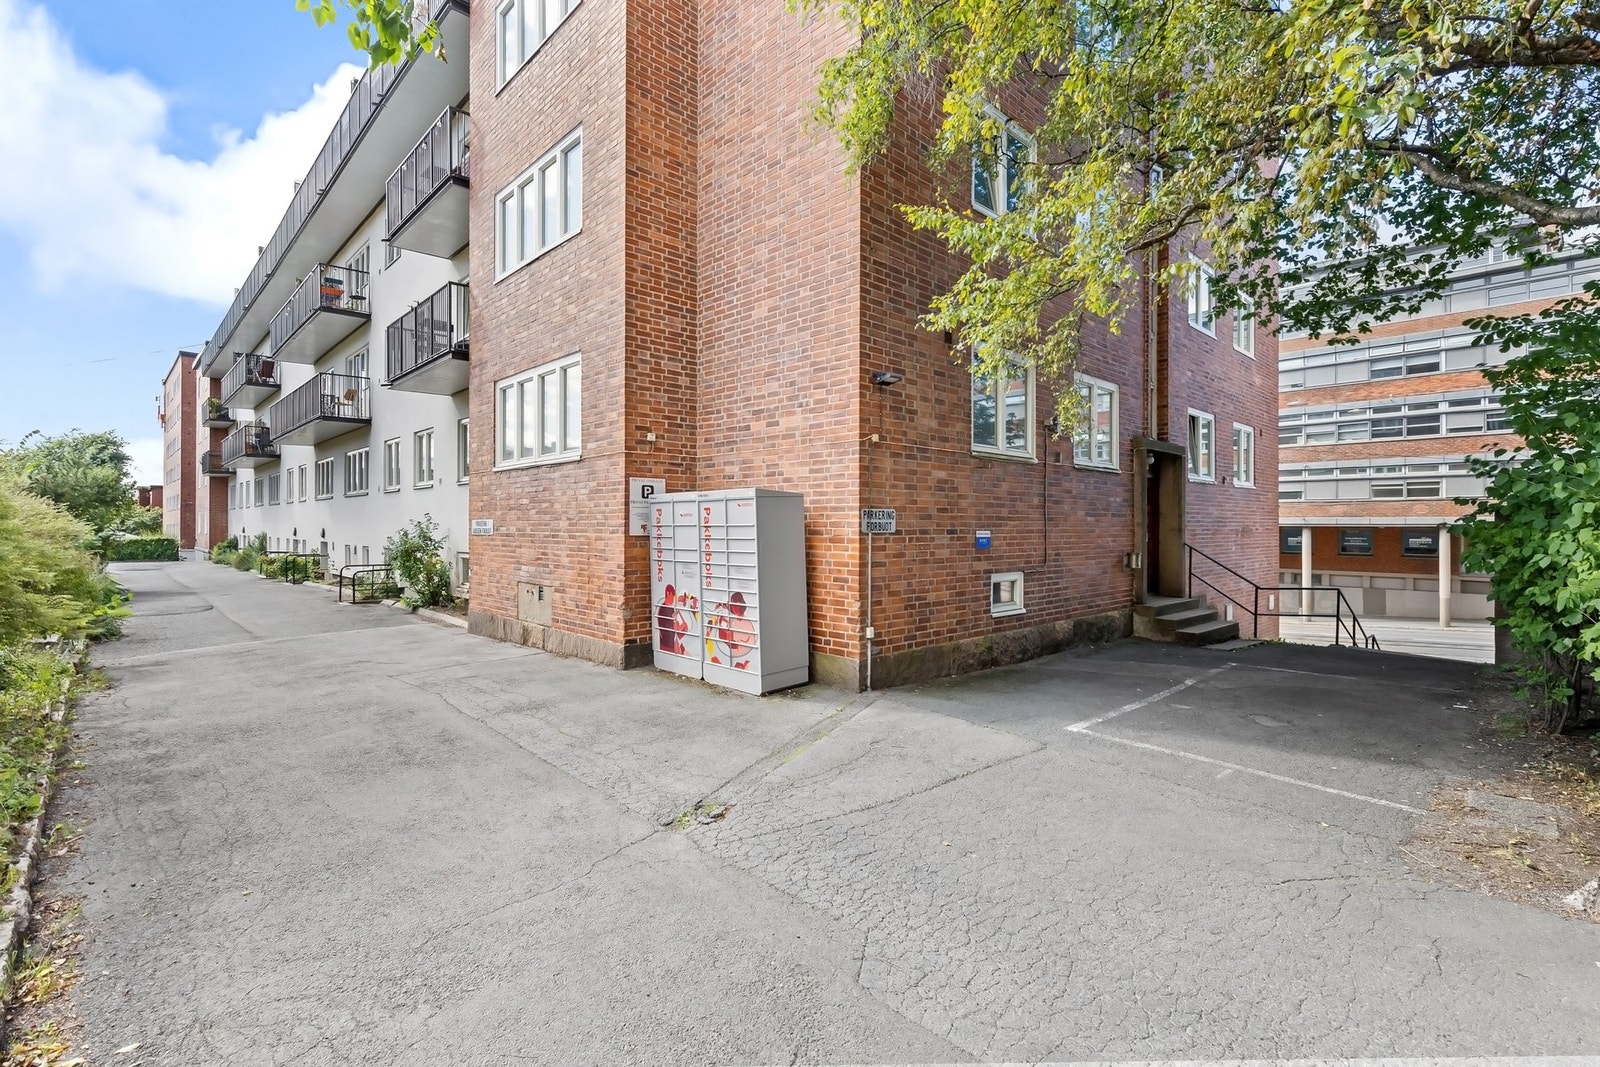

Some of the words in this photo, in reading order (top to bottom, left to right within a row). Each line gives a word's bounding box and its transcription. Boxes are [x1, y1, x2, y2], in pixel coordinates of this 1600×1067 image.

[644, 486, 652, 498] P
[863, 510, 895, 520] PARKERING
[656, 508, 664, 583] Pakkeboks
[703, 507, 713, 588] Pakkeboks
